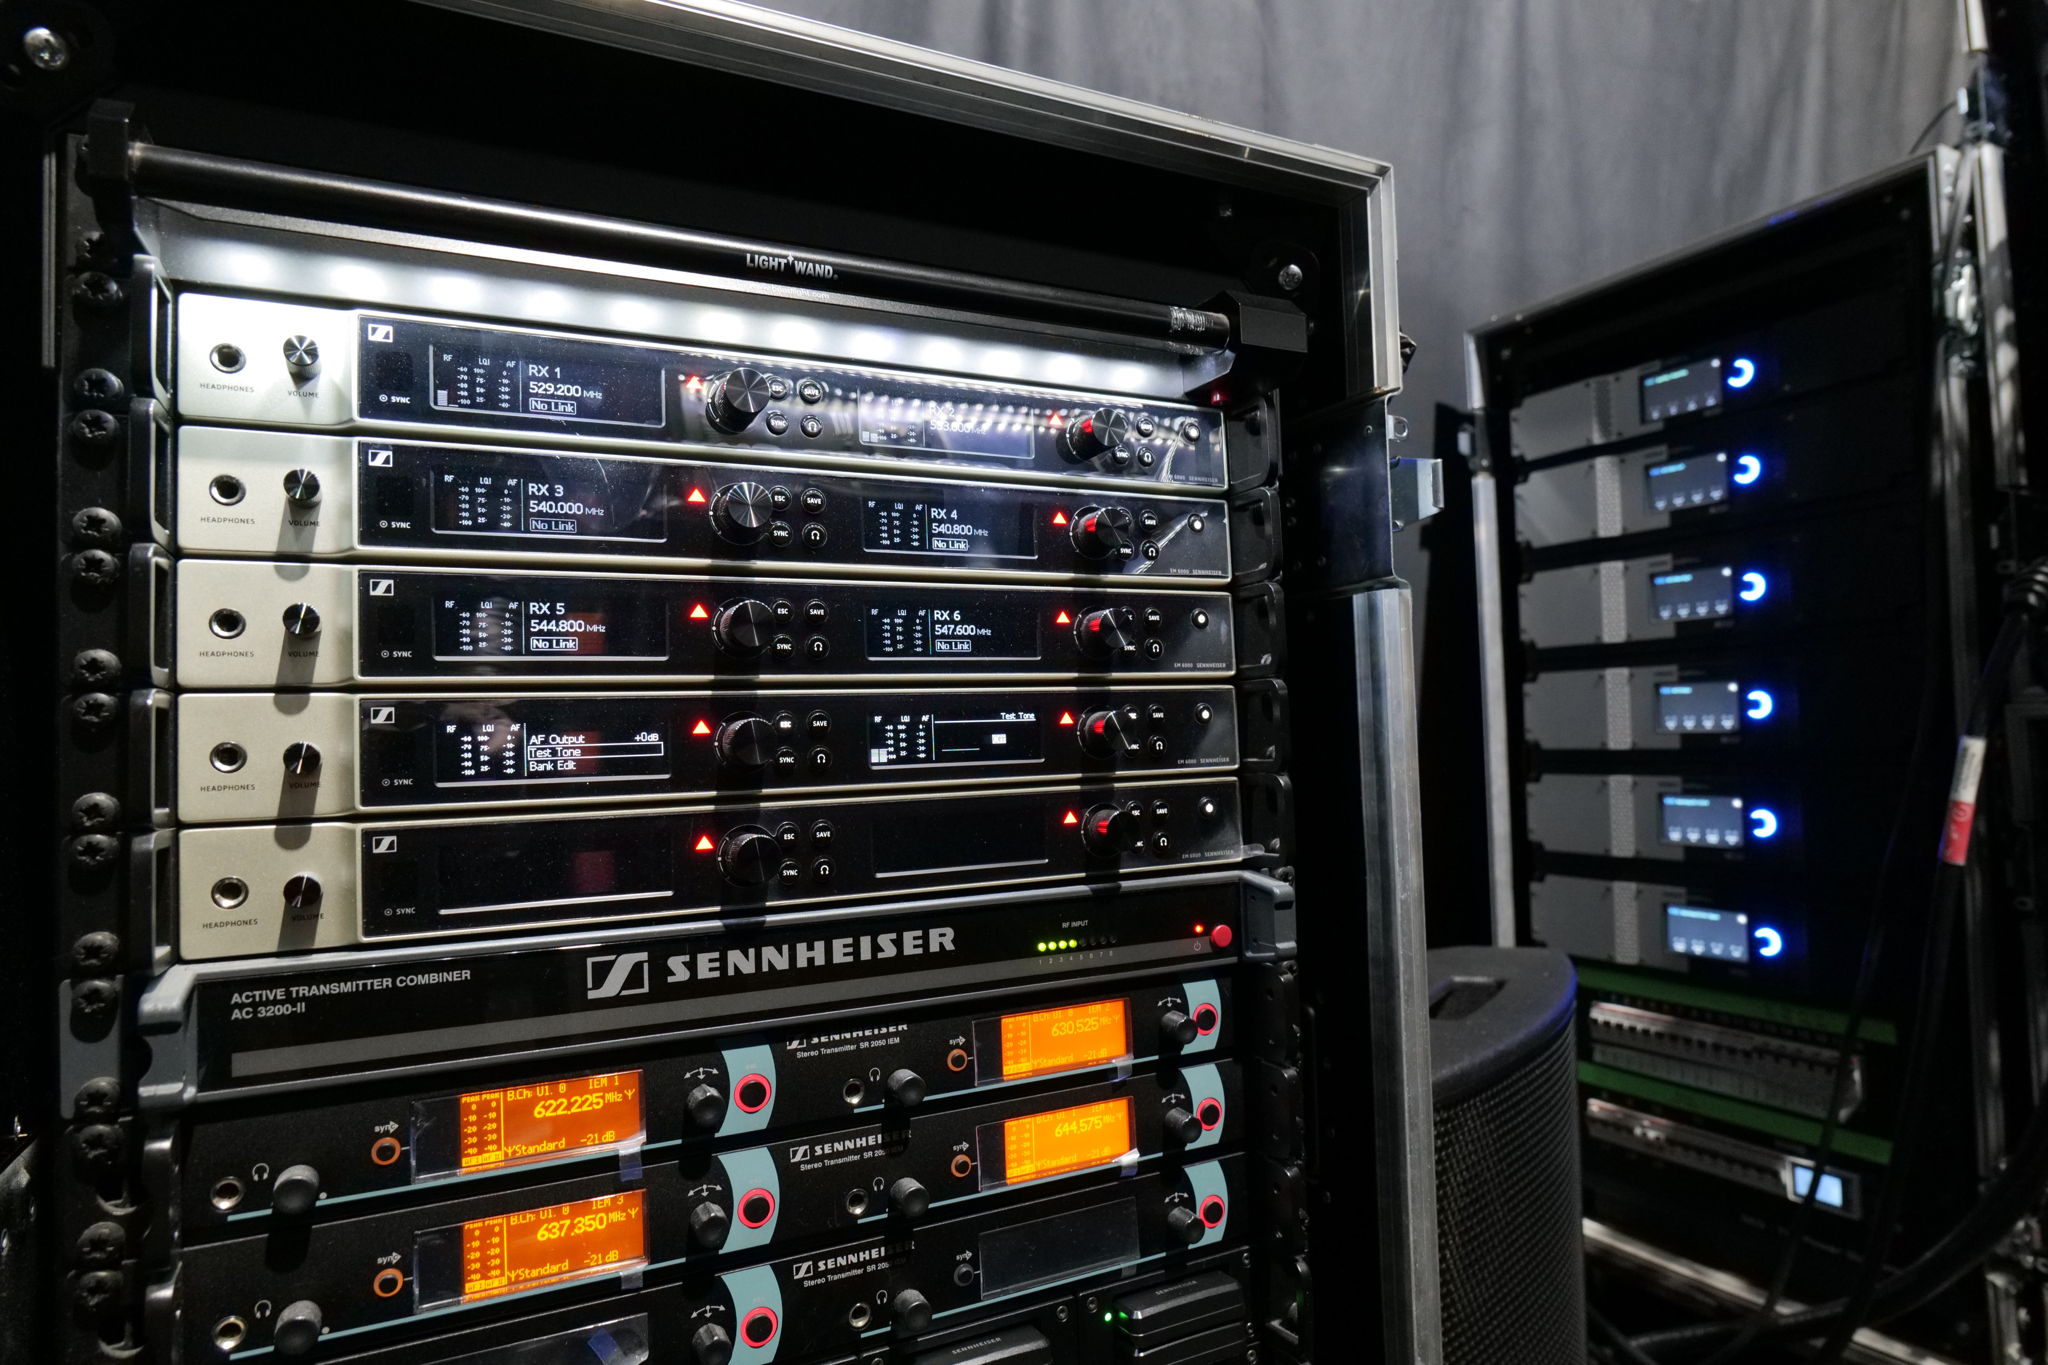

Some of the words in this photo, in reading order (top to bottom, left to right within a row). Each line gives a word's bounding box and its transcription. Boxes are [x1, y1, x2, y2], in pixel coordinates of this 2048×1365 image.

[746, 253, 787, 272] LIGHT
[443, 354, 452, 362] RF
[506, 360, 516, 368] AF
[528, 365, 549, 378] RX
[555, 367, 561, 379] 1
[200, 383, 255, 393] HEADPHONES
[287, 390, 319, 398] VOLUME
[529, 381, 582, 397] 529.200
[583, 391, 602, 399] MHz
[391, 395, 410, 404] SYNC
[531, 399, 547, 411] No
[552, 401, 574, 413] Link
[528, 483, 549, 496] RX
[555, 485, 564, 497] 3
[529, 501, 583, 515] 540.000
[585, 508, 604, 516] MHz
[931, 508, 946, 519] RX
[950, 509, 958, 519] 4
[200, 516, 255, 525] HEADPHONES
[391, 521, 411, 529] SYNC
[532, 519, 547, 530] No
[552, 520, 575, 531] Link
[932, 523, 972, 536] 540.800
[974, 529, 989, 537] MHz
[934, 540, 947, 548] No
[949, 540, 967, 549] Link
[529, 602, 550, 615] RX
[556, 603, 565, 615] 5
[934, 610, 950, 620] RX
[954, 610, 961, 621] 6
[530, 620, 584, 633] 544.800
[586, 625, 606, 633] MHz
[935, 624, 976, 636] 547.600
[976, 628, 991, 636] MHz
[533, 639, 549, 649] No
[553, 638, 576, 649] Link
[938, 642, 950, 650] No
[952, 641, 969, 650] Link
[392, 650, 412, 658] SYNC
[1001, 712, 1016, 720] Test
[447, 725, 456, 733] RF
[510, 723, 521, 731] AF
[530, 735, 545, 745] AF
[550, 734, 586, 745] Output
[634, 732, 659, 742] +0dB
[530, 747, 552, 758] Test
[556, 747, 581, 757] Tone
[530, 761, 554, 771] Bank
[558, 761, 576, 770] Edit
[200, 784, 255, 792] HEADPHONES
[203, 919, 258, 928] HEADPHONES
[1071, 920, 1089, 928] INPUT
[666, 927, 955, 983] SENNHEISER
[231, 988, 286, 1005] ACTIVE
[290, 977, 393, 998] TRANSMITTER
[396, 970, 471, 988] COMBINER
[231, 1008, 254, 1021] AC
[257, 1002, 306, 1018] 3200-II
[796, 1049, 819, 1059] Stereo
[821, 1044, 857, 1055] Transmitter
[859, 1041, 869, 1049] SR
[871, 1039, 886, 1047] 2050
[887, 1037, 900, 1045] IEM
[588, 1077, 608, 1090] IEM
[614, 1075, 619, 1086] 1
[533, 1093, 604, 1119] 622.225
[604, 1092, 622, 1103] MHz
[515, 1138, 566, 1156] Standard
[580, 1135, 600, 1145] -21
[601, 1131, 615, 1142] dB
[800, 1161, 822, 1171] Stereo
[824, 1154, 861, 1167] Transmitter
[863, 1151, 874, 1159] SR
[592, 1198, 611, 1210] IEM
[537, 1213, 607, 1241] 637.350
[608, 1211, 626, 1223] MHz
[519, 1259, 569, 1280] Standard
[583, 1254, 602, 1266] -21
[605, 1250, 619, 1262] dB
[803, 1276, 826, 1288] Stereo
[827, 1266, 864, 1282] Transmitter
[866, 1264, 876, 1272] SR
[952, 1337, 1001, 1355] SENNHEISER
